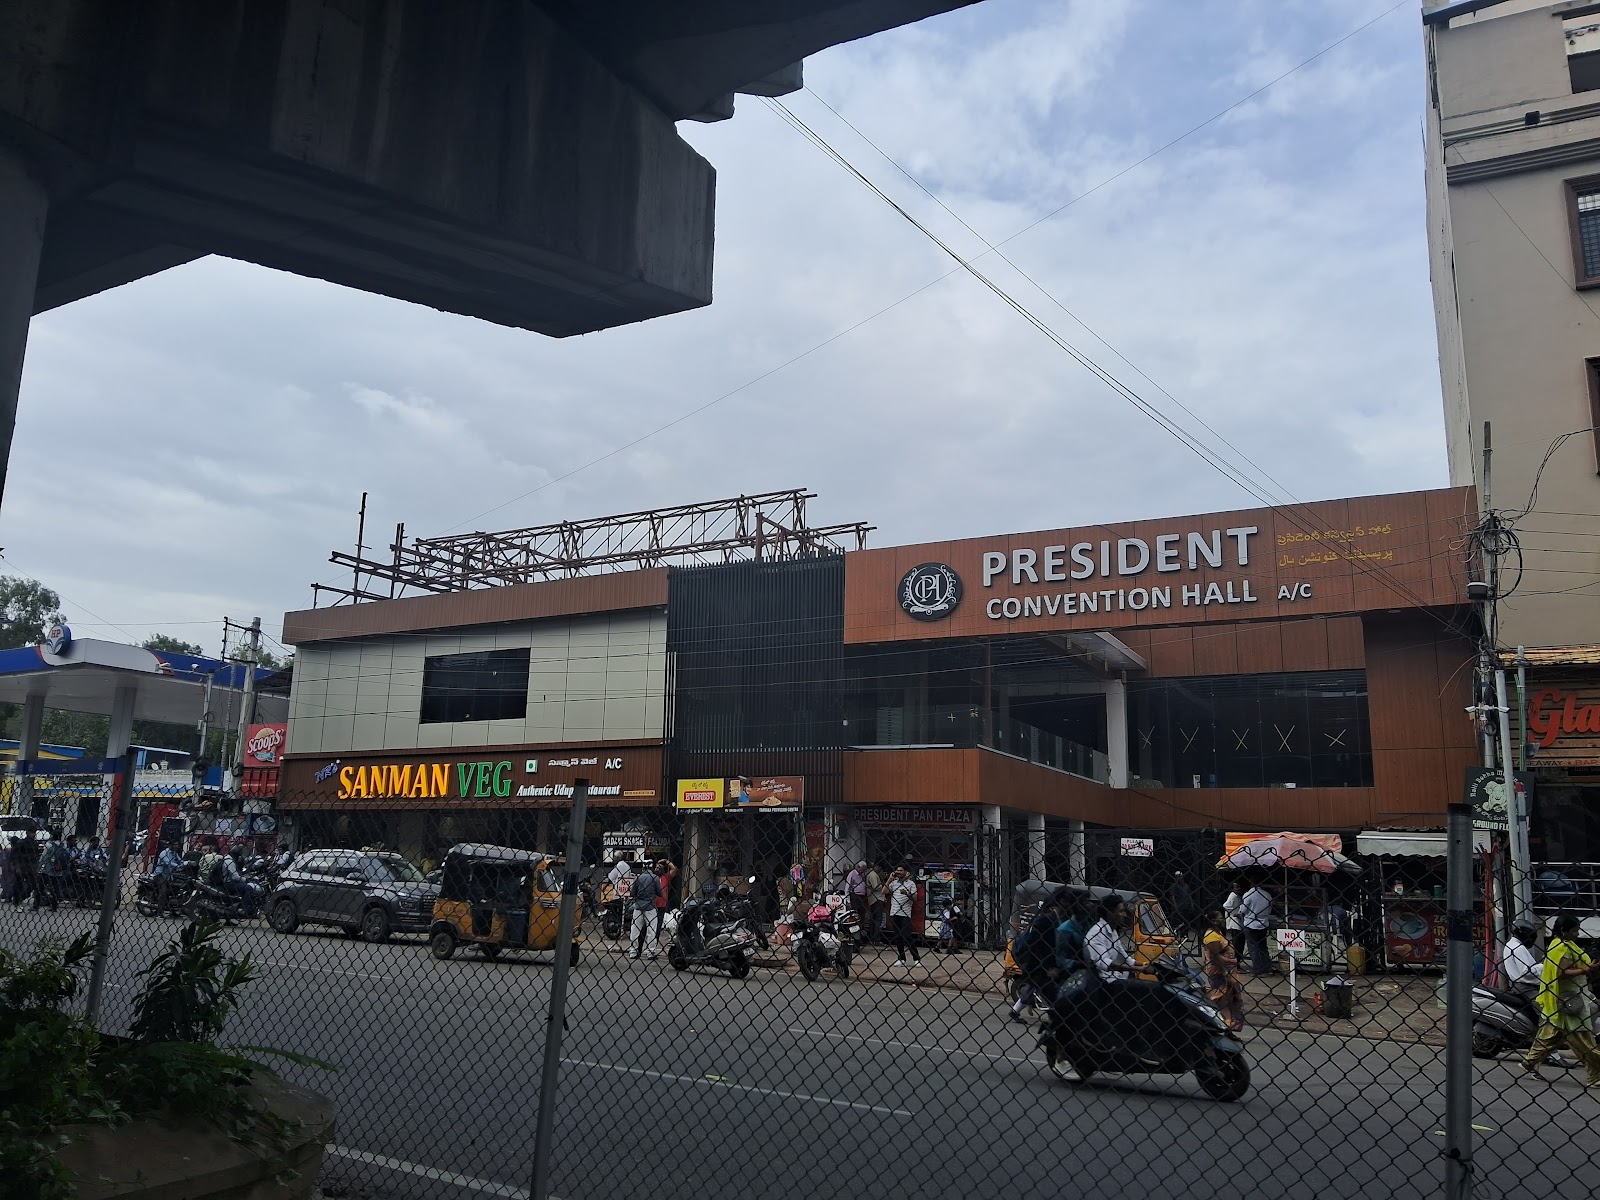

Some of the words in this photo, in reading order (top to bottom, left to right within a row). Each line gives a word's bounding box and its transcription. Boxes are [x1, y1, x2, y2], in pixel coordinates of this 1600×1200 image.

[982, 526, 1258, 587] PRESIDENT
[1278, 582, 1312, 601] A/C
[985, 585, 1171, 619] CONVENTION
[1182, 580, 1257, 606] HALL
[604, 757, 622, 769] A/C
[338, 763, 451, 799] SANMAN
[456, 761, 512, 798] VEG
[516, 784, 553, 797] Authentic
[685, 791, 715, 801] EVEREST
[854, 808, 910, 820] PRESIDENT
[913, 809, 934, 821] PAN
[936, 810, 970, 822] PLAZA
[1472, 820, 1499, 830] GROUND
